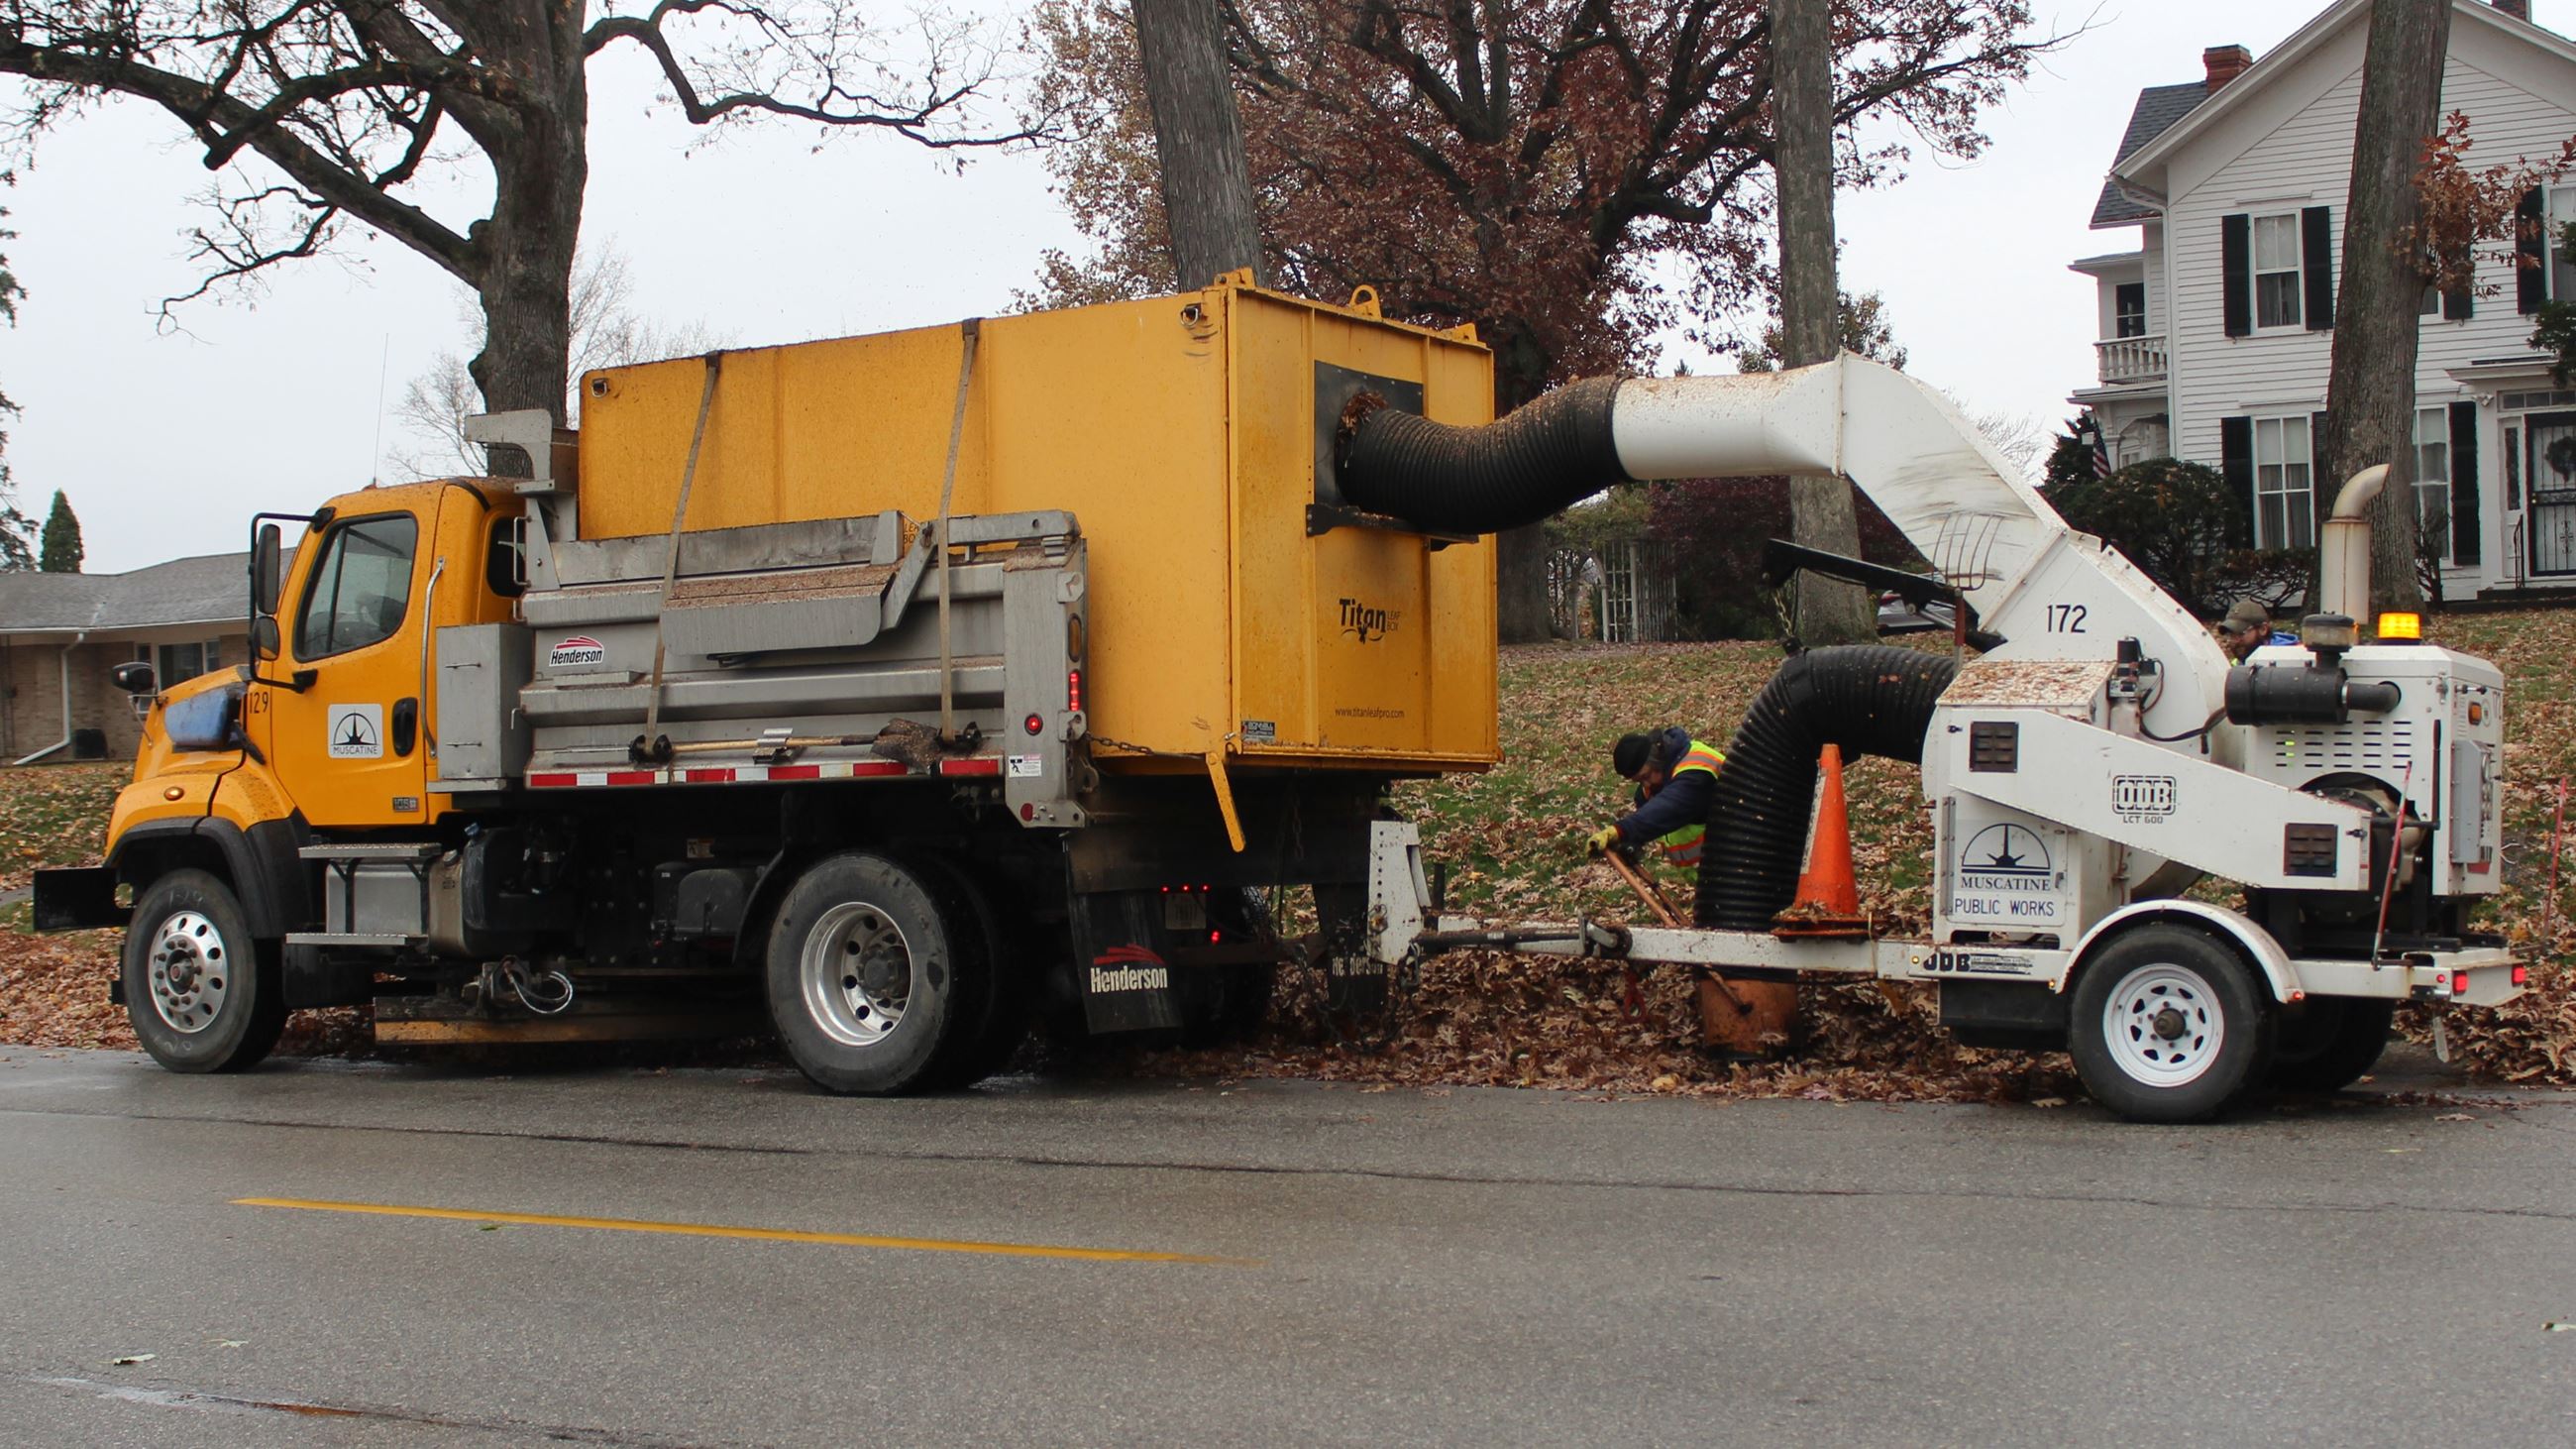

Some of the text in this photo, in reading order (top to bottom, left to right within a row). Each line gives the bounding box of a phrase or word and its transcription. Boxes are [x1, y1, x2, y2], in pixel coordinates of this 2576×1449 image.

[1340, 598, 1386, 633] Titan
[2047, 605, 2087, 633] 172
[551, 649, 602, 665] Henderson
[249, 692, 268, 714] 129
[333, 745, 378, 755] MUSCATINE
[2115, 778, 2174, 812] ODB
[2122, 815, 2141, 824] LCT
[1961, 876, 2052, 891] MUSCATINE
[1955, 898, 2055, 917] PUBLIC WORKS
[1090, 964, 1168, 993] Henderson
